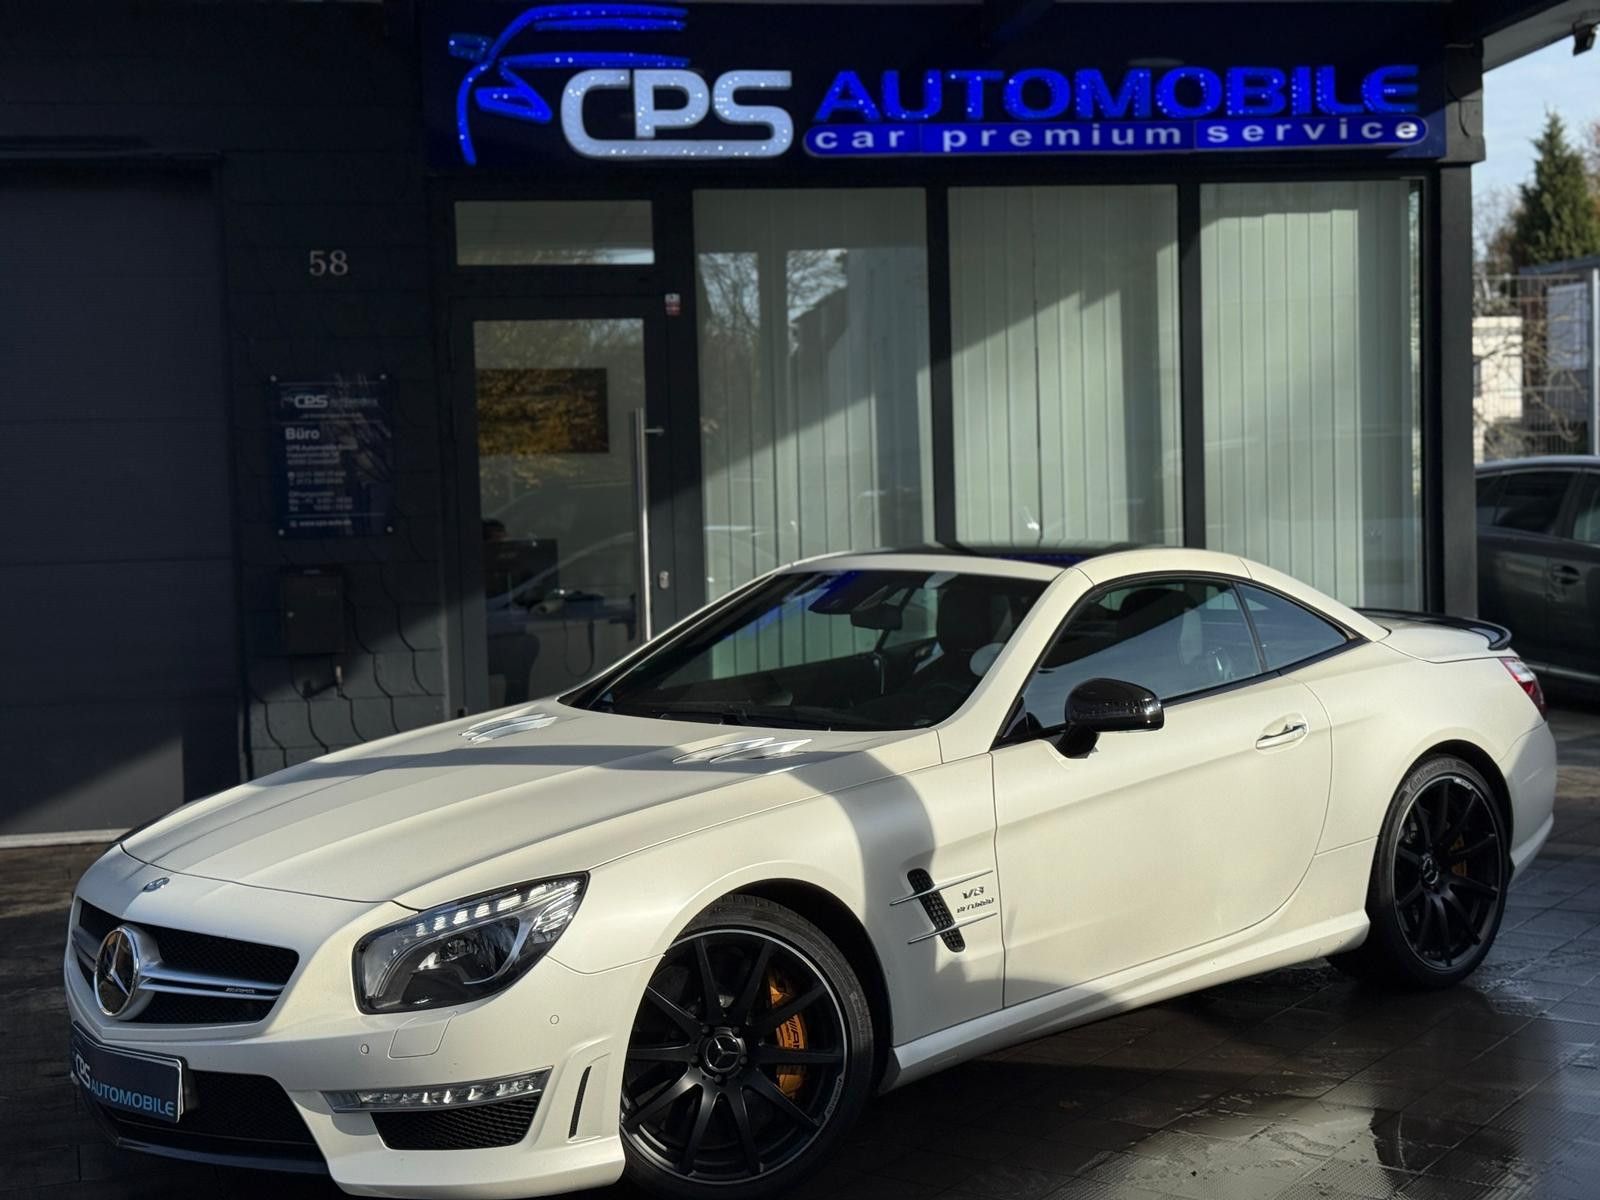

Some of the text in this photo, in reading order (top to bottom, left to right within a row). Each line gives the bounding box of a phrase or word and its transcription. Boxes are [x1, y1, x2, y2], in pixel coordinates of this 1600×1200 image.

[560, 65, 1419, 158] CPS AUTOMOBILE
[815, 117, 1419, 152] car premium service
[309, 249, 348, 276] 58
[294, 395, 328, 408] CPS
[285, 428, 320, 440] Büro
[962, 886, 985, 899] V8
[75, 1054, 175, 1117] CPS AUTOMOBILE
